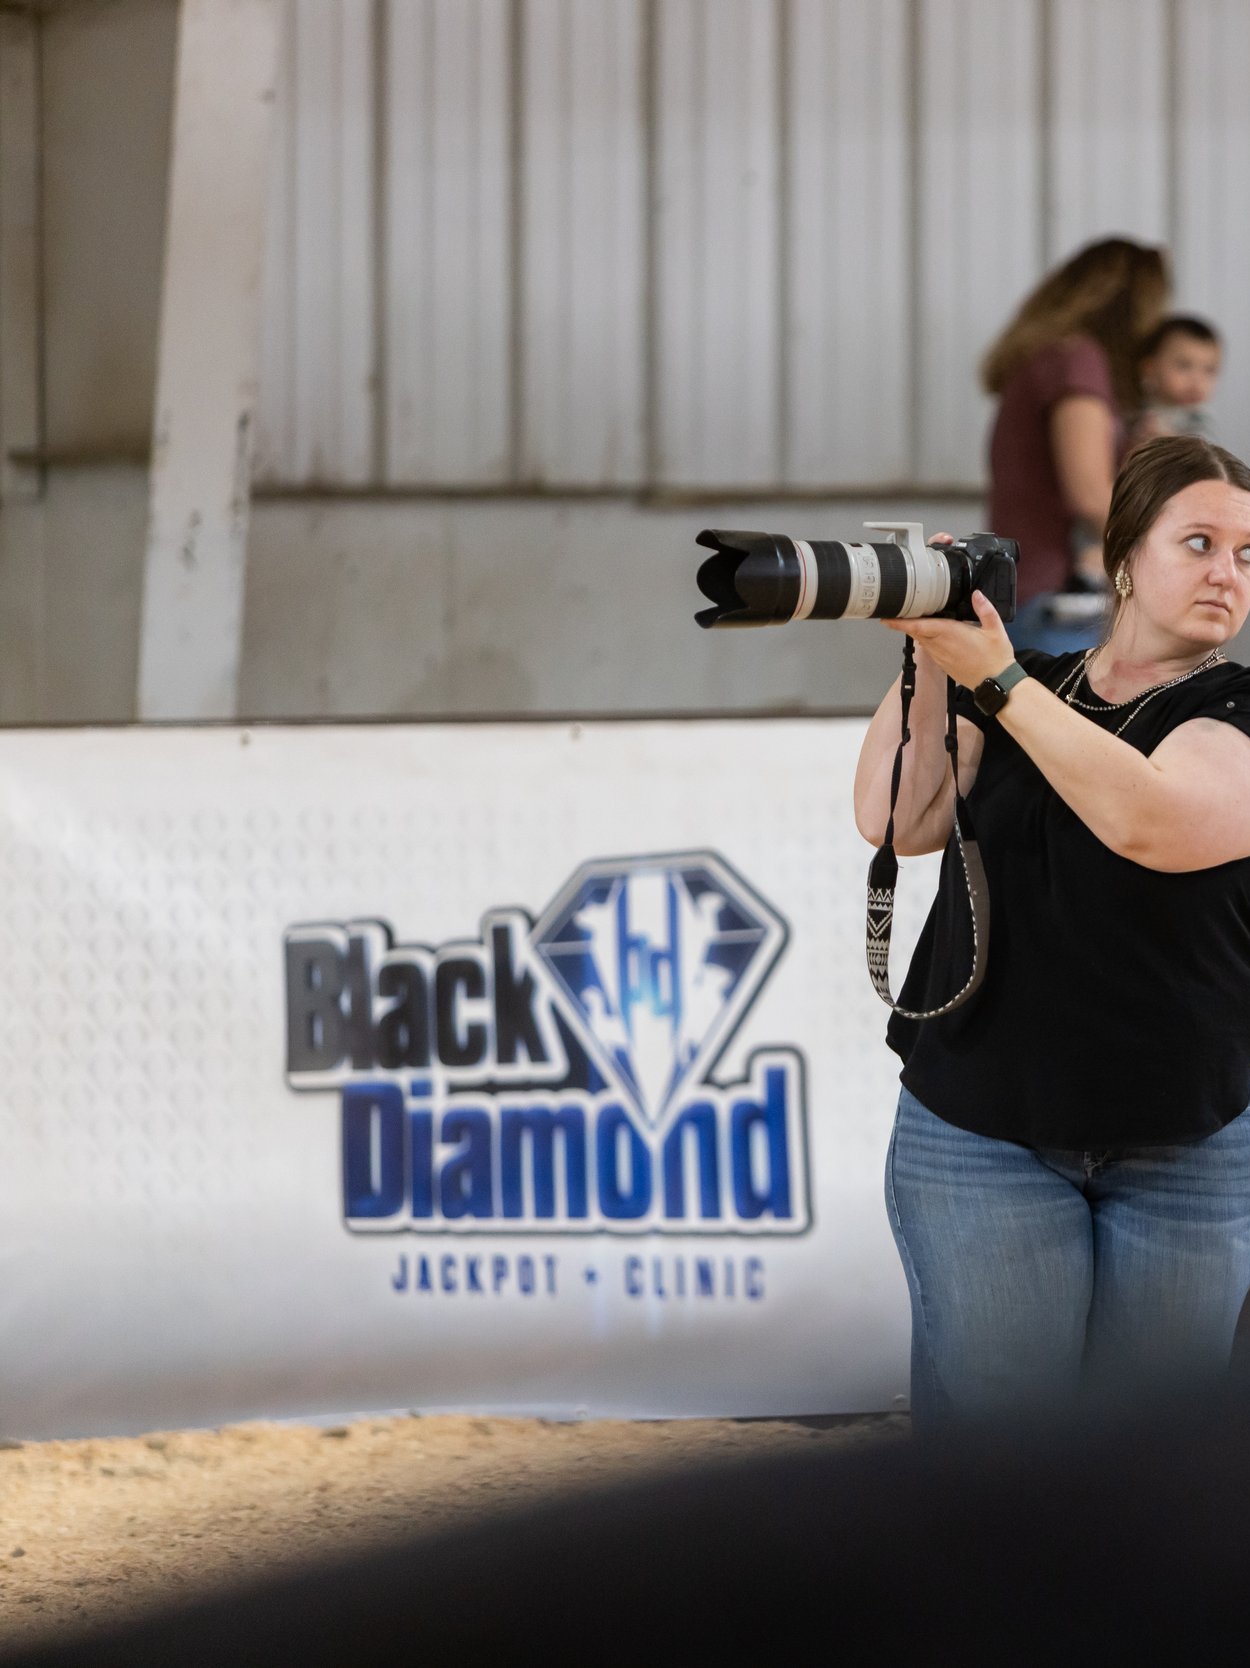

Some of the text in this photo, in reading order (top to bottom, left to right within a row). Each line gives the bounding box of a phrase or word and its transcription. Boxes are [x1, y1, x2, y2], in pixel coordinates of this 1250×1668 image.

[285, 923, 552, 1073] Black
[342, 1066, 794, 1220] Diamond
[391, 1252, 766, 1299] JACKPOT CLINIC
